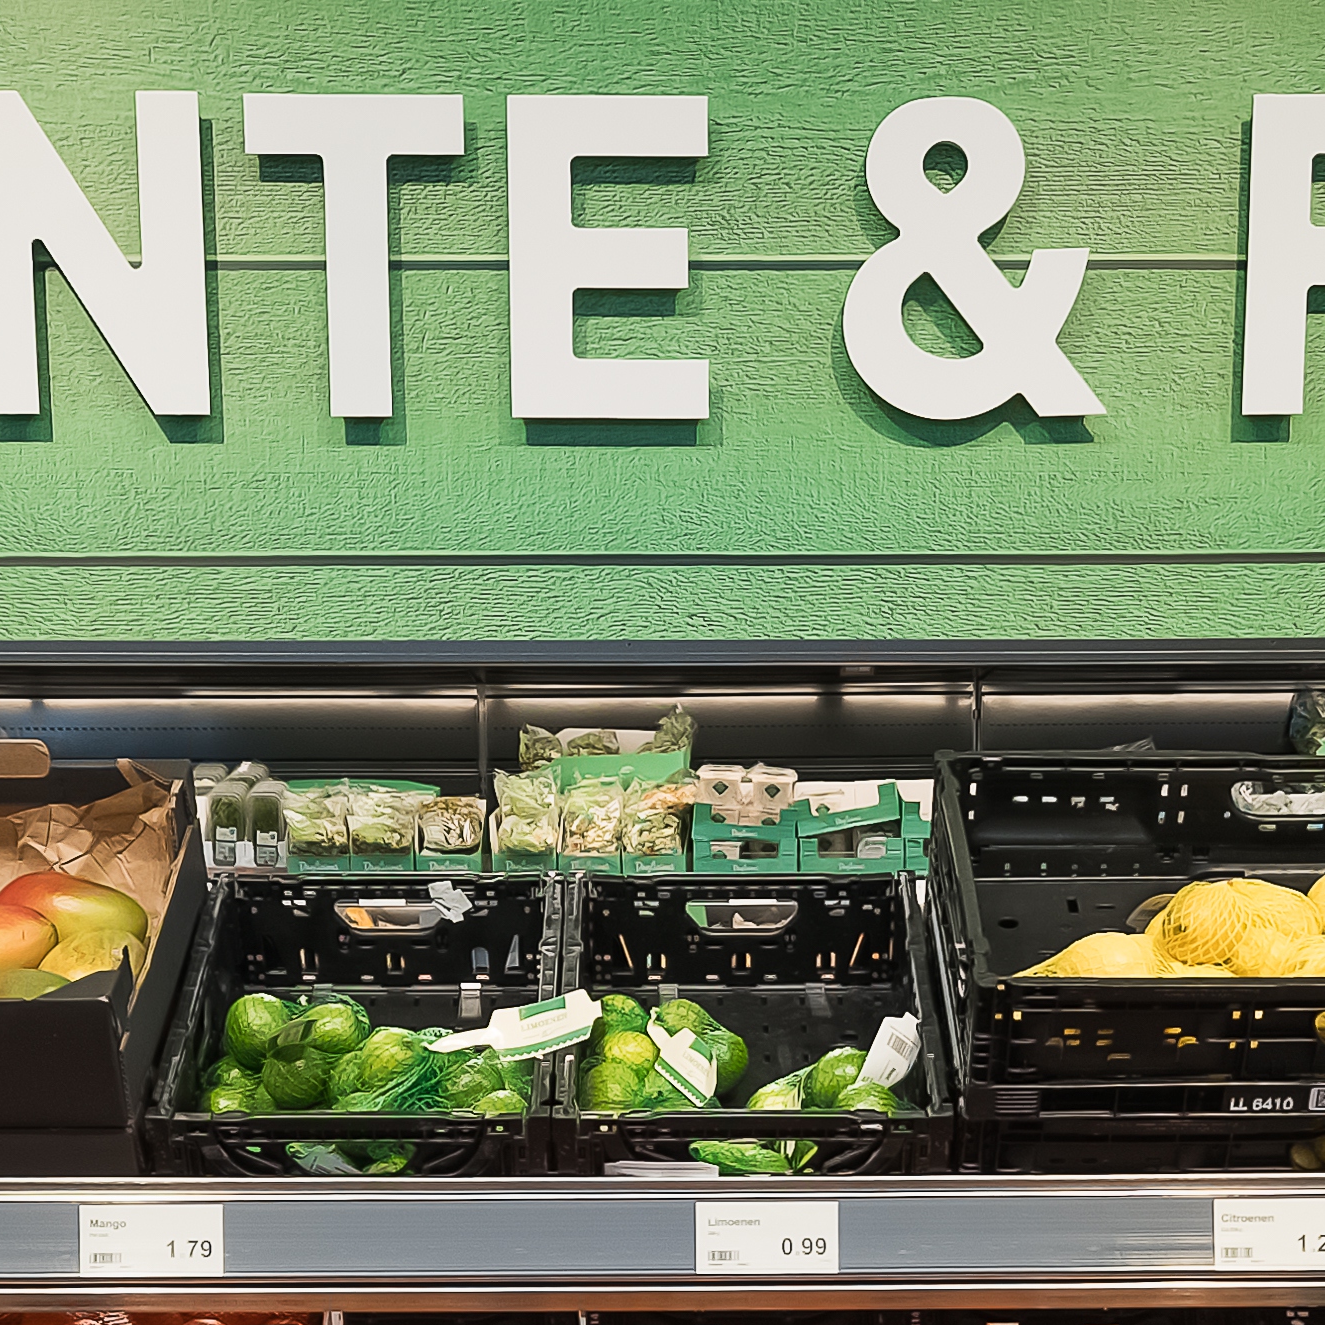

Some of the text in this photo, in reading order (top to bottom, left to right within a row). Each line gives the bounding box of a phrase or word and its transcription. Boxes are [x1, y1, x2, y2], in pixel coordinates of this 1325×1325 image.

[842, 96, 1107, 423] &
[1252, 1098, 1294, 1111] 6410
[89, 1219, 127, 1230] Mango
[708, 1218, 761, 1227] Limoenen
[1221, 1213, 1275, 1223] Citroenen
[166, 1239, 213, 1258] 1.79
[781, 1237, 827, 1256] 0.99
